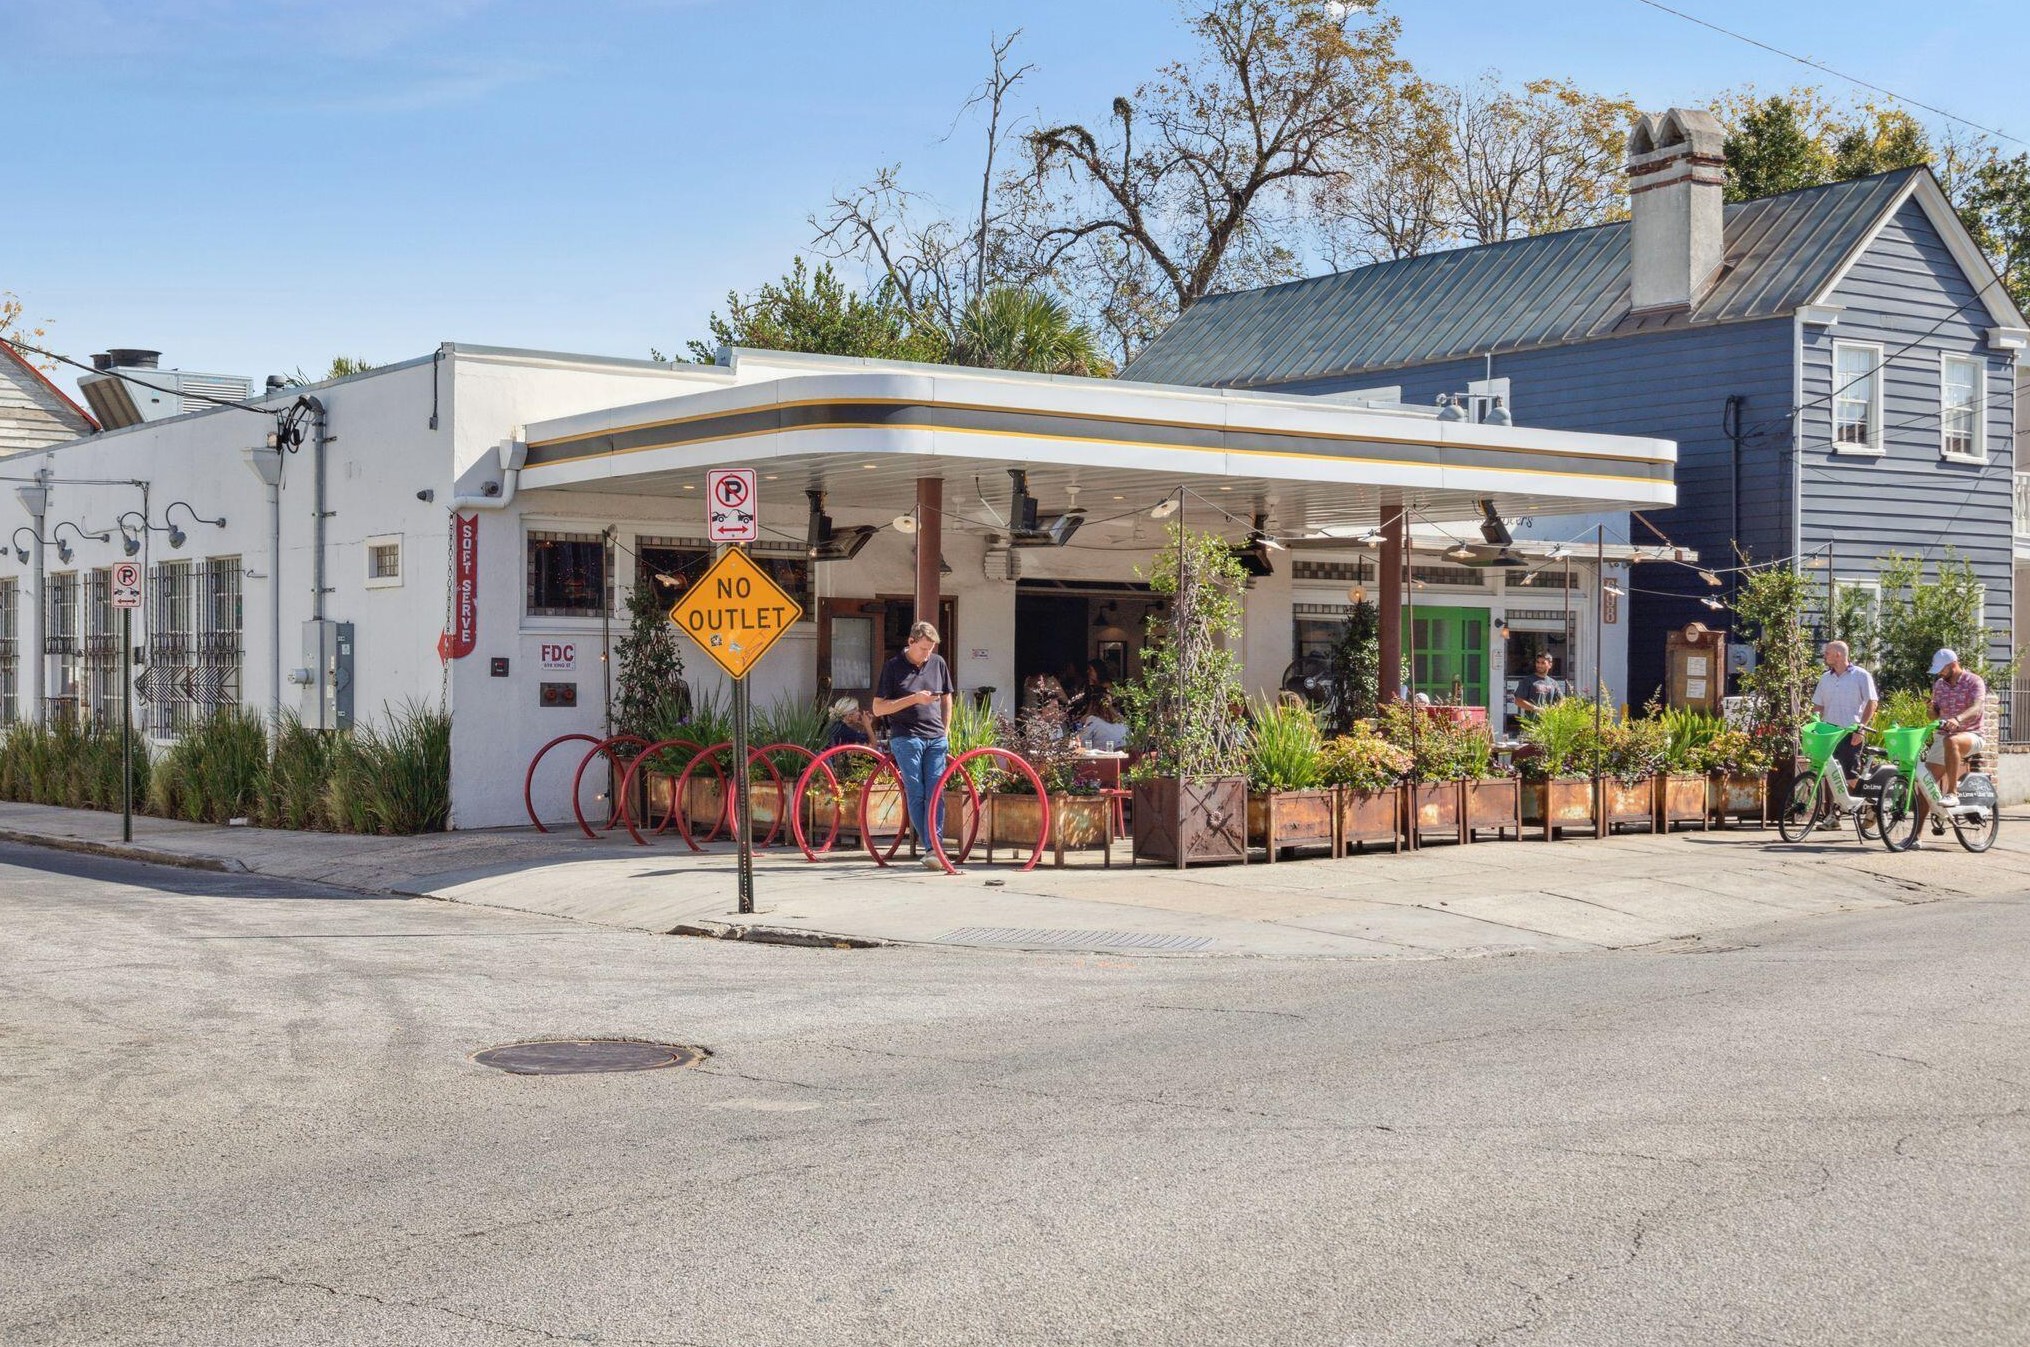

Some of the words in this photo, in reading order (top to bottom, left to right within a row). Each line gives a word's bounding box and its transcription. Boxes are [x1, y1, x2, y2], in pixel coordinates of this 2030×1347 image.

[724, 480, 742, 502] P
[462, 525, 472, 574] SOFT
[123, 569, 133, 583] P
[717, 576, 751, 599] NO
[461, 579, 471, 642] SERVE
[688, 607, 785, 631] OUTLET
[541, 644, 574, 662] FDC
